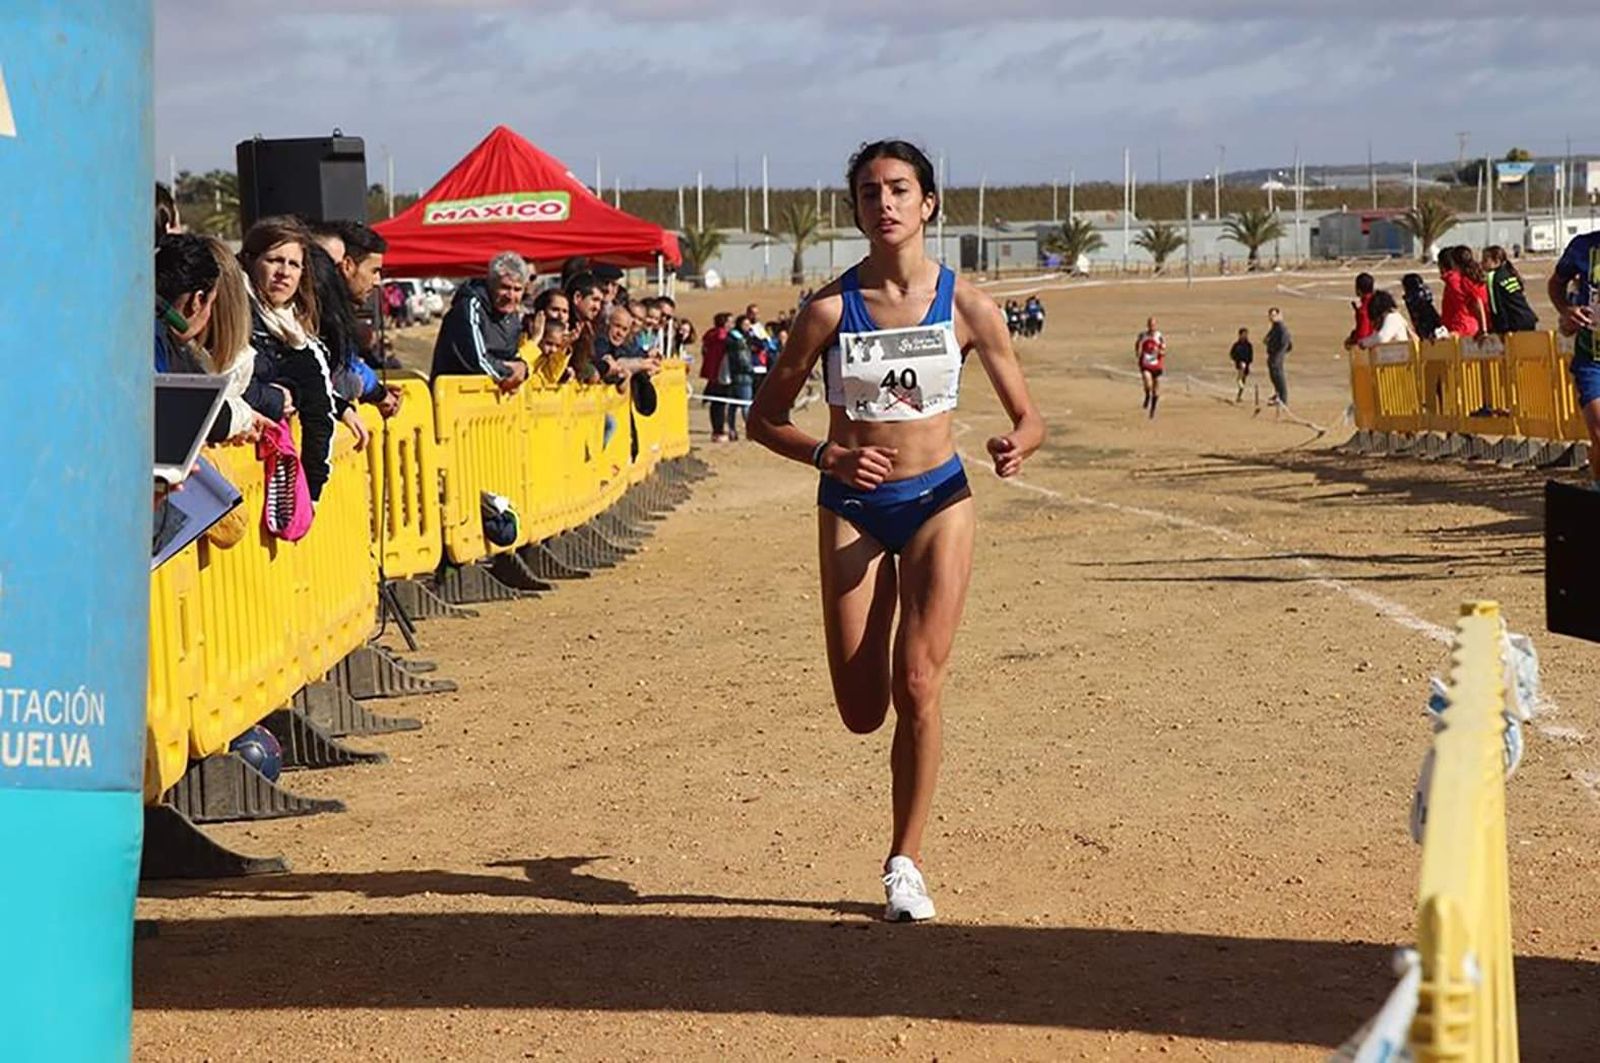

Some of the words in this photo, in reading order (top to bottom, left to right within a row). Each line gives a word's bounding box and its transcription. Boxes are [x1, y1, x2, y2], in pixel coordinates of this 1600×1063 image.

[431, 202, 562, 221] MAXICO
[880, 368, 917, 390] 40
[0, 685, 105, 726] TACIÓN
